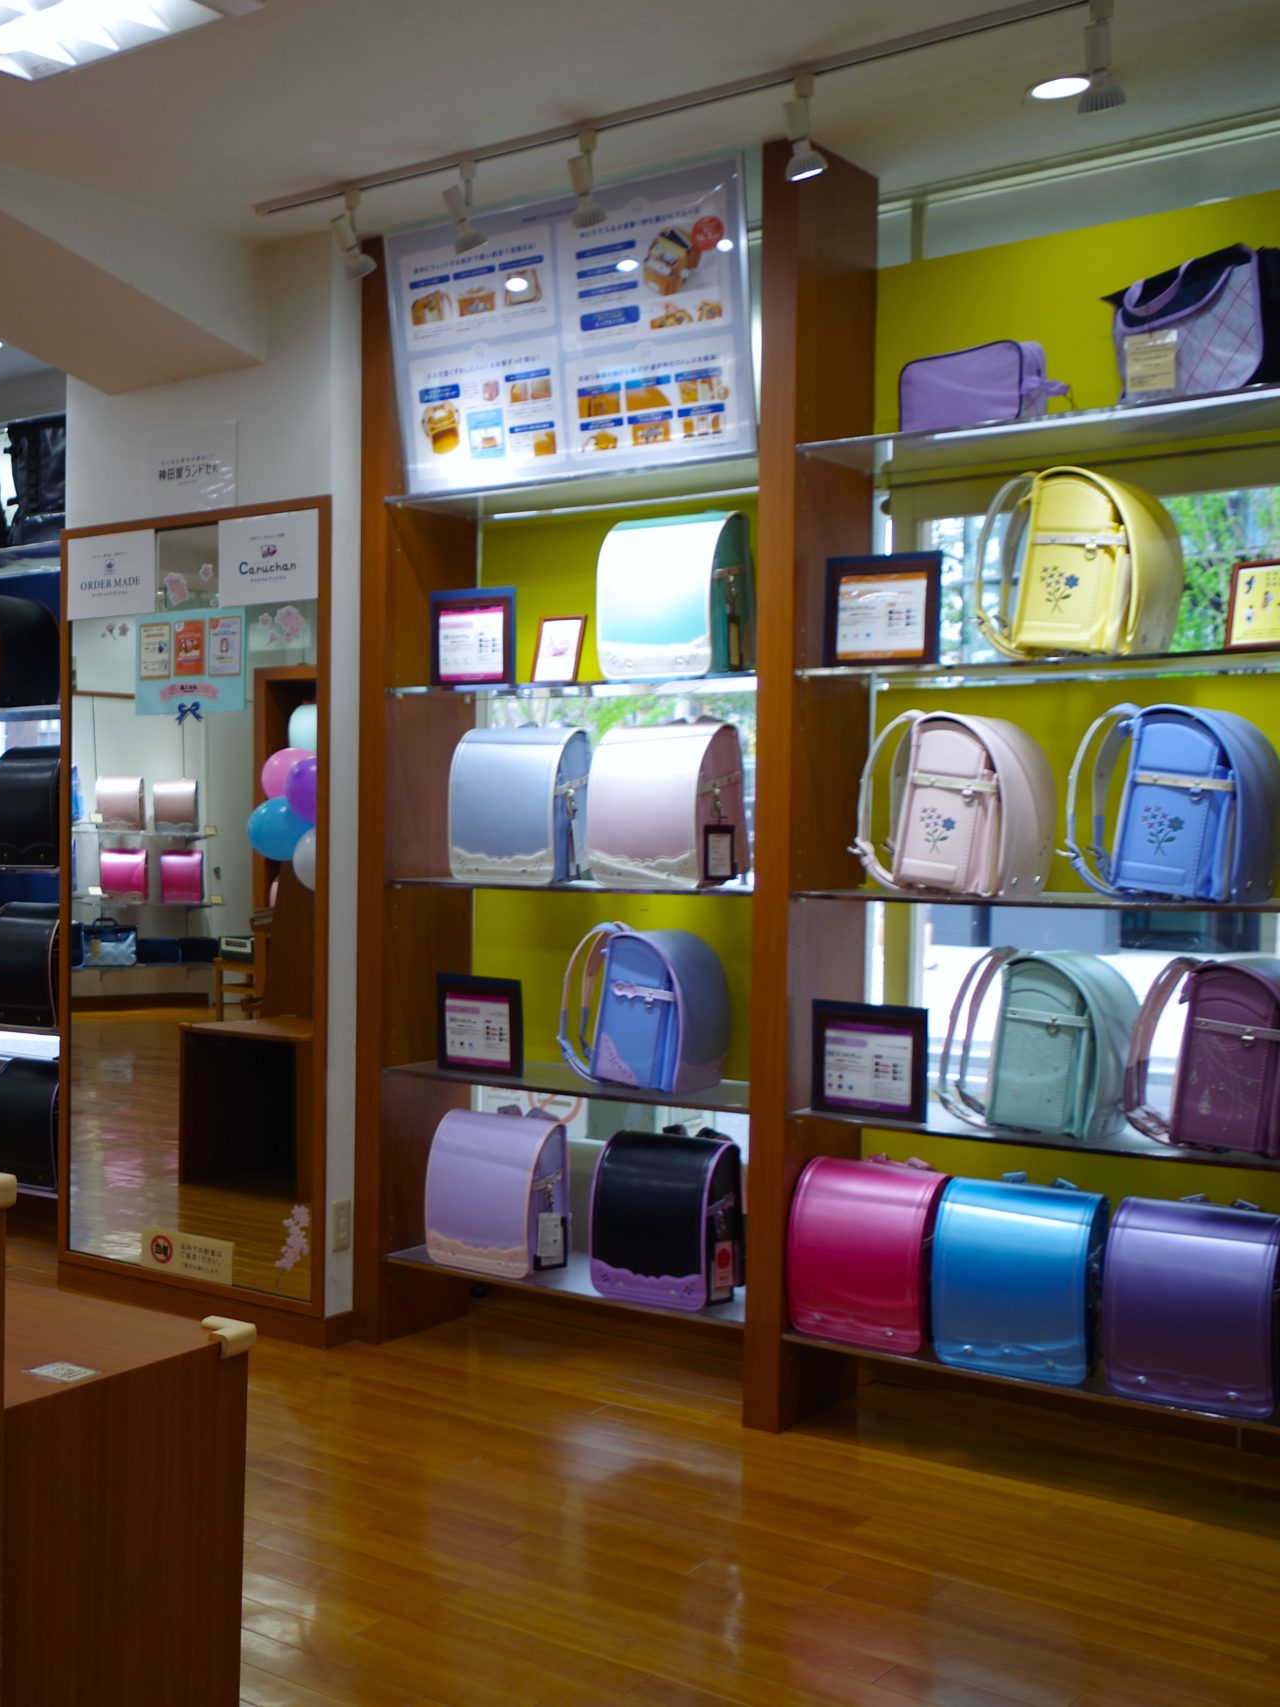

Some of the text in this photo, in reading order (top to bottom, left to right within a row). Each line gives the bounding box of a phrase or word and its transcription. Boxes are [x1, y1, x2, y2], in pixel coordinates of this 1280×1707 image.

[239, 561, 297, 575] Caruchan
[80, 576, 141, 590] ORDER MADE
